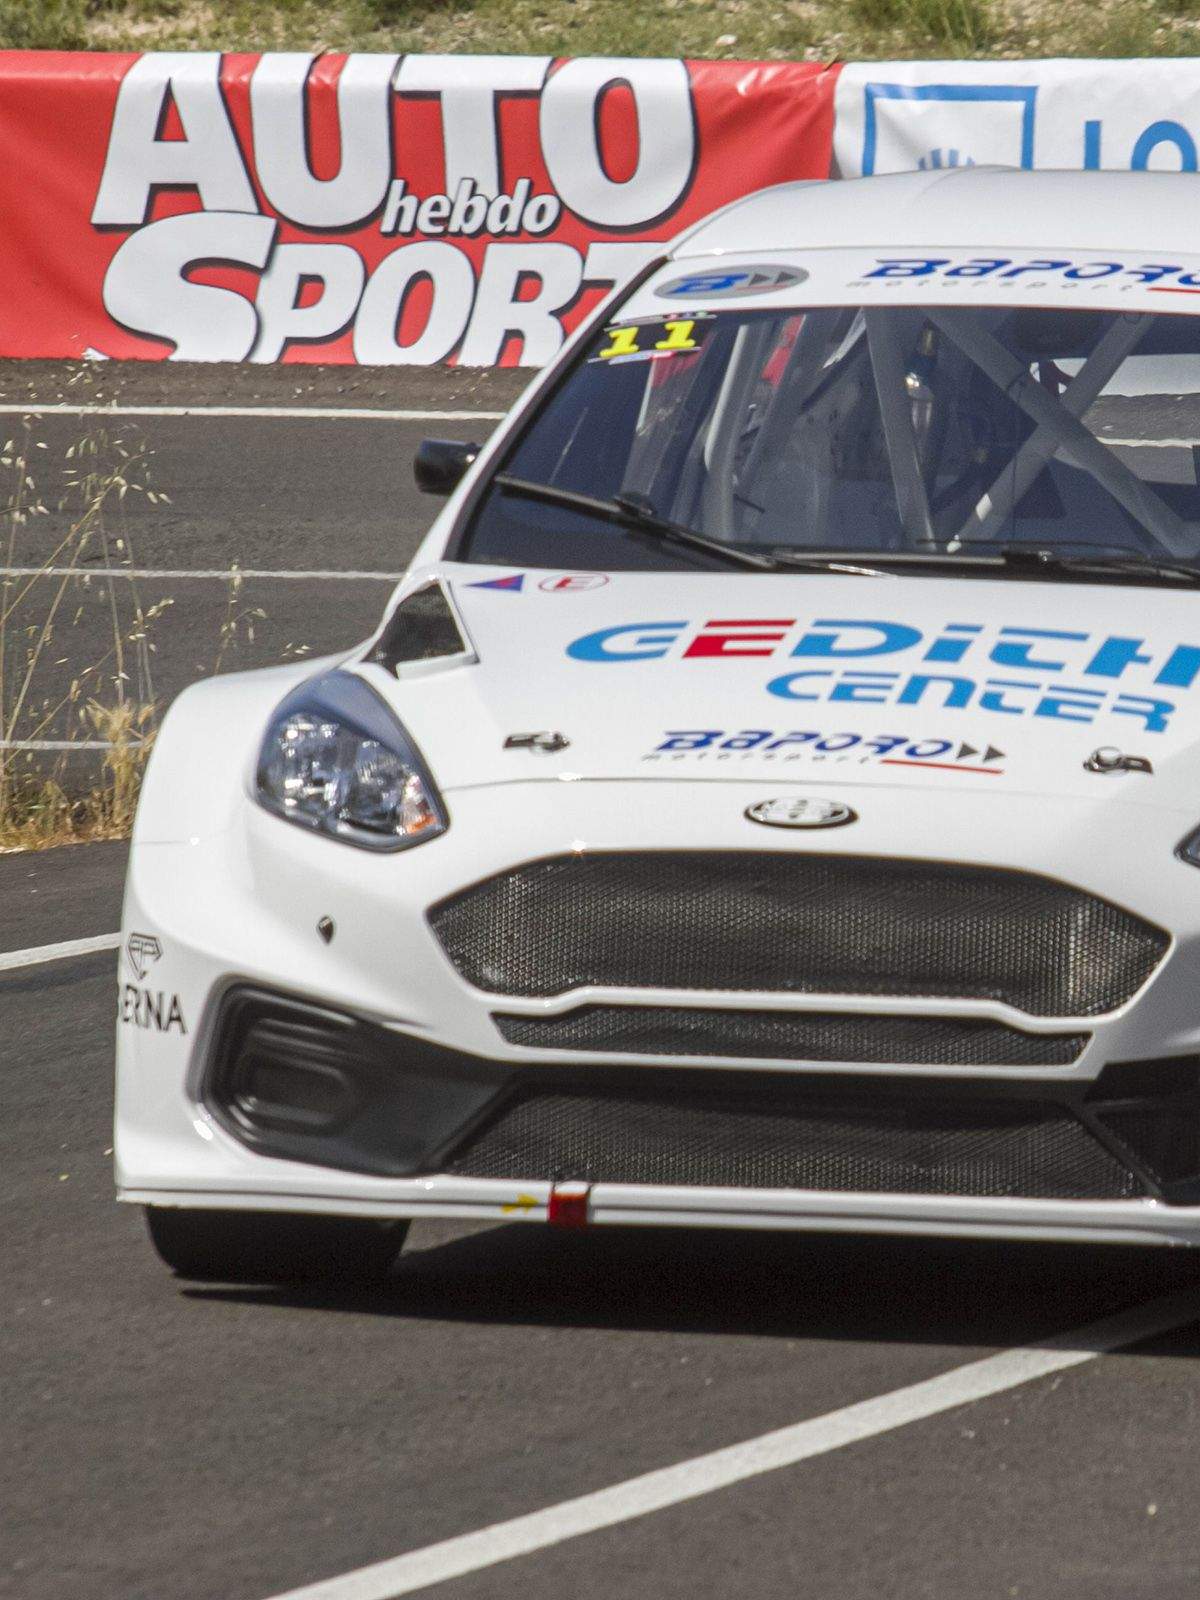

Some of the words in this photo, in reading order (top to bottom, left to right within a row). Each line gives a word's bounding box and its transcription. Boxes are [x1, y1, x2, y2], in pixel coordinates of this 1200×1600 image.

[91, 52, 696, 229] AUTO
[381, 178, 561, 236] hebdo
[600, 320, 697, 358] 11
